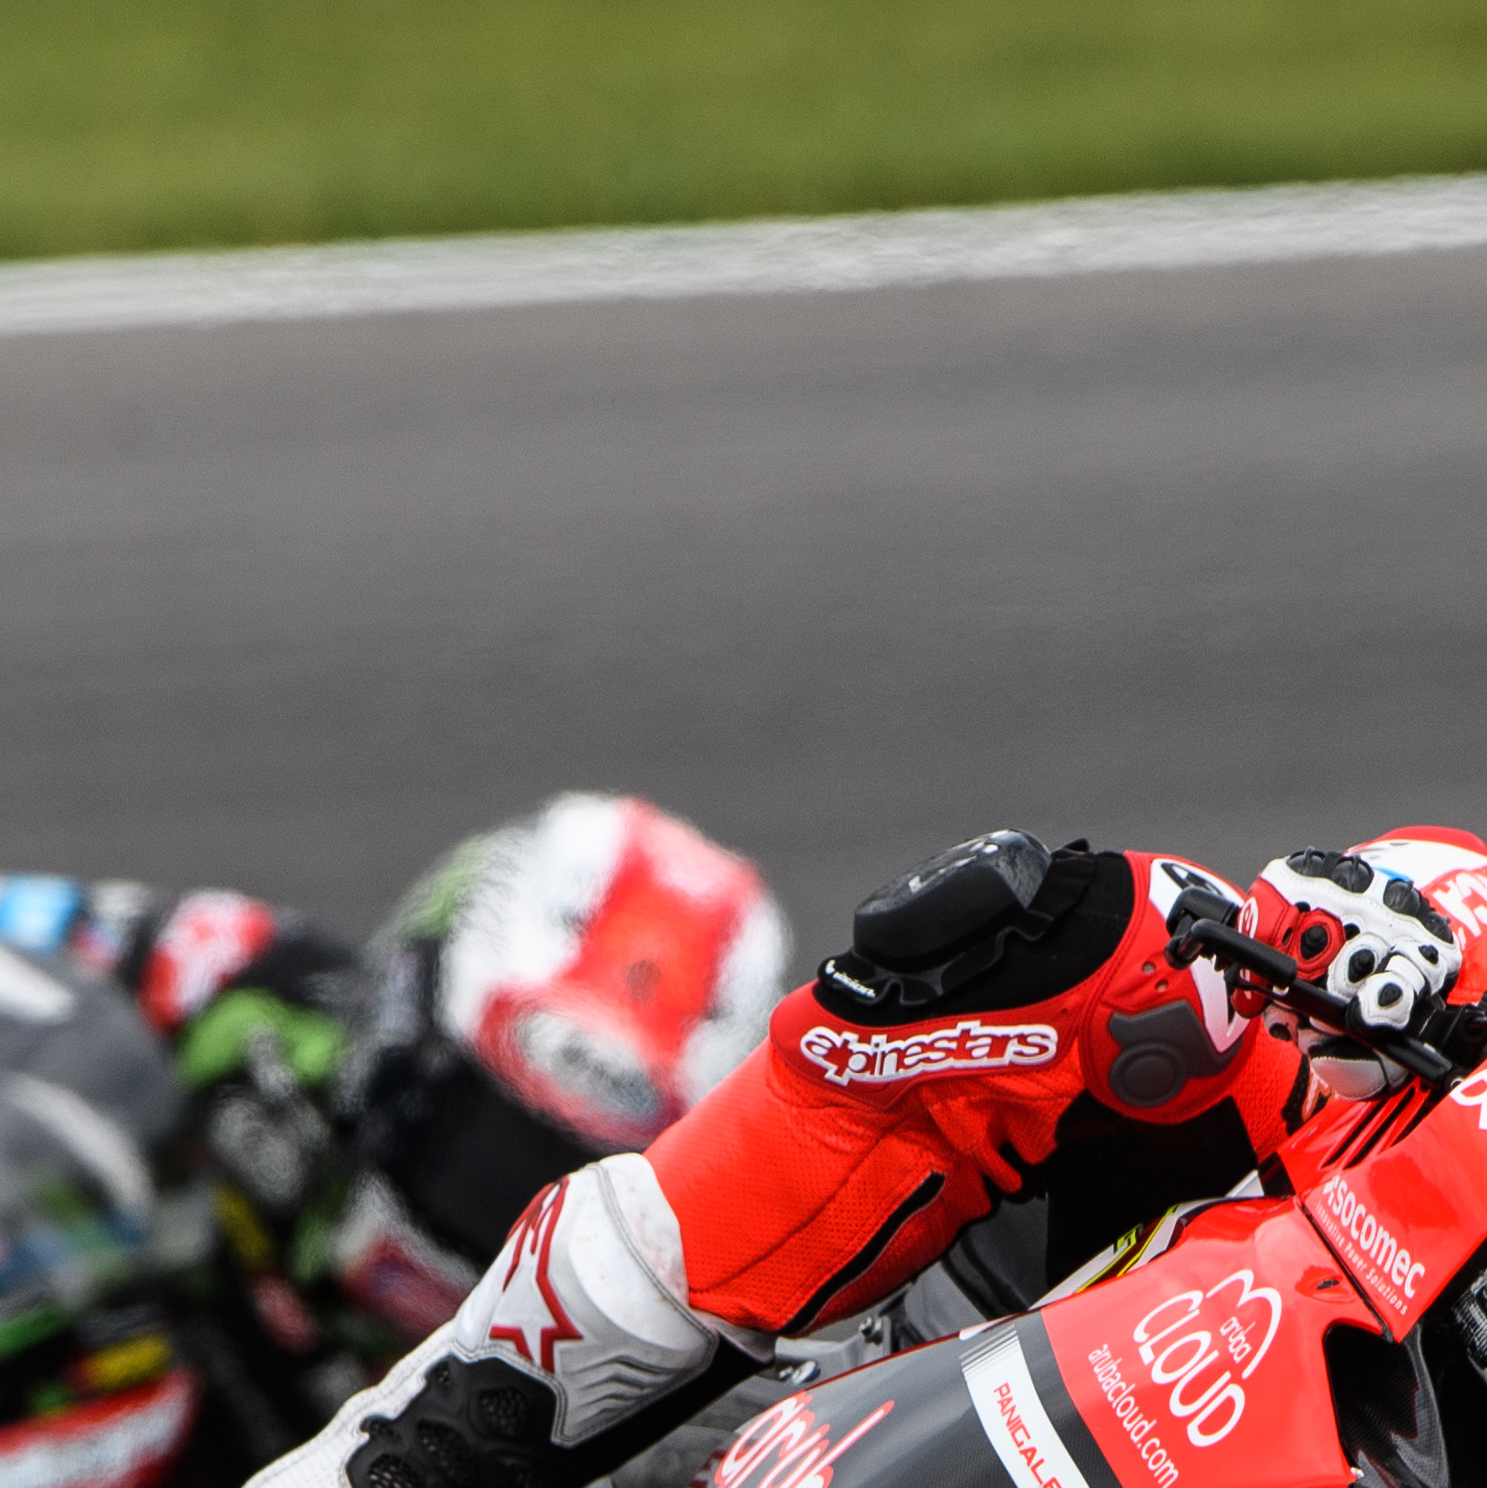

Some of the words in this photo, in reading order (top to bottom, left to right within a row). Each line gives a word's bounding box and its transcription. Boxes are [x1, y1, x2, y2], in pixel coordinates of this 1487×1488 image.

[800, 1020, 1058, 1087] alpinestars
[1133, 1290, 1245, 1447] CLOUD
[1220, 1316, 1256, 1364] aruba
